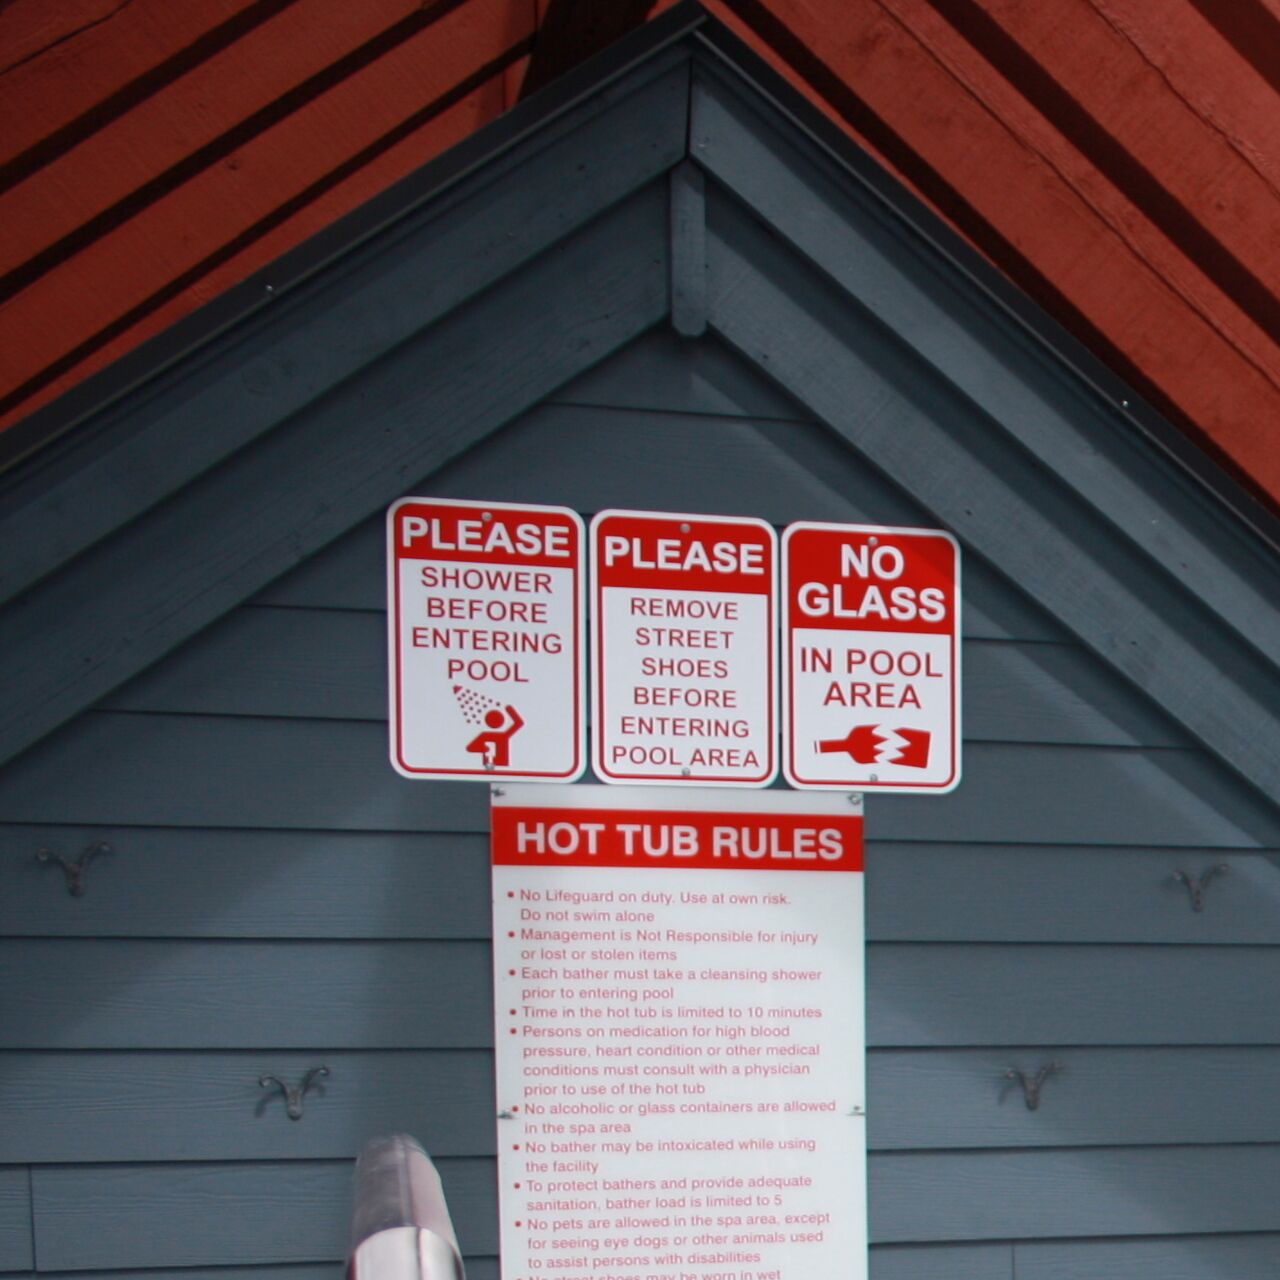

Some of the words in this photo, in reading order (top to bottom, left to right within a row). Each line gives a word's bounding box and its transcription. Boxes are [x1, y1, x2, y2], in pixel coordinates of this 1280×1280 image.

[402, 517, 570, 557] PLEASE
[604, 535, 764, 575] PLEASE
[841, 544, 904, 580] NO
[421, 566, 552, 595] SHOWER
[426, 597, 548, 624] BEFORE
[631, 597, 738, 621] REMOVE
[798, 582, 945, 622] GLASS
[412, 627, 563, 655] ENTERING
[635, 627, 734, 649] STREET
[447, 659, 529, 683] POOL
[641, 657, 728, 679] SHOES
[801, 647, 832, 674] IN
[846, 648, 943, 678] POOL
[633, 687, 737, 709] BEFORE
[823, 681, 921, 710] AREA
[620, 716, 749, 738] ENTERING
[612, 746, 682, 766] POOL
[690, 747, 759, 768] AREA
[517, 822, 605, 854] HOT
[617, 825, 698, 856] TUB
[713, 827, 843, 860] RULES
[520, 888, 541, 901] No
[546, 888, 613, 905] Lifeguard
[619, 892, 636, 902] on
[641, 890, 675, 906] duty.
[680, 890, 707, 903] Use
[712, 891, 724, 903] at
[729, 894, 757, 904] own
[763, 891, 790, 904] risk.
[521, 908, 541, 920] Do
[546, 908, 568, 921] not
[574, 908, 610, 921] swim
[615, 909, 654, 921] alone
[520, 928, 615, 944] Management
[620, 928, 632, 941] is
[636, 928, 661, 941] Not
[666, 928, 753, 945] Responsible
[757, 929, 776, 941] for
[780, 929, 817, 945] injury
[521, 950, 536, 960] or
[540, 947, 566, 960] lost
[571, 950, 586, 960] or
[591, 947, 634, 960] stolen
[639, 947, 677, 960] items
[521, 966, 557, 979] Each
[563, 967, 609, 979] bather
[614, 967, 648, 979] must
[653, 967, 683, 979] take
[688, 970, 696, 979] a
[700, 967, 767, 983] cleansing
[772, 967, 821, 980] shower
[522, 986, 555, 1002] prior
[560, 986, 574, 998] to
[579, 986, 638, 1002] entering
[641, 986, 673, 1002] pool
[522, 1024, 582, 1037] Persons
[586, 1027, 604, 1037] on
[609, 1024, 688, 1036] medication
[692, 1024, 711, 1036] for
[715, 1024, 746, 1040] high
[750, 1024, 789, 1036] blood
[523, 1046, 590, 1059] pressure,
[596, 1043, 632, 1056] heart
[637, 1043, 702, 1056] condition
[707, 1046, 721, 1056] or
[725, 1043, 762, 1055] other
[766, 1043, 819, 1055] medical
[525, 1101, 545, 1114] No
[550, 1101, 614, 1114] alcoholic
[619, 1104, 635, 1113] or
[638, 1100, 675, 1116] glass
[680, 1099, 753, 1113] containers
[757, 1102, 779, 1112] are
[784, 1099, 836, 1112] allowed
[525, 1121, 537, 1133] in
[542, 1121, 565, 1133] the
[570, 1123, 595, 1136] spa
[600, 1123, 631, 1133] area
[525, 1140, 546, 1153] No
[551, 1139, 596, 1152] bather
[602, 1142, 631, 1155] may
[636, 1139, 653, 1151] be
[658, 1138, 734, 1151] intoxicated
[738, 1137, 774, 1150] while
[779, 1137, 815, 1153] using
[526, 1159, 548, 1172] the
[553, 1159, 598, 1175] facility
[527, 1178, 542, 1192] To
[548, 1177, 598, 1194] protect
[602, 1176, 656, 1190] bathers
[660, 1176, 687, 1189] and
[691, 1175, 743, 1192] provide
[748, 1174, 812, 1191] adequate
[527, 1217, 548, 1230] No
[552, 1216, 583, 1232] pets
[587, 1218, 610, 1228] are
[615, 1214, 671, 1228] allowed
[674, 1214, 686, 1227] in
[691, 1213, 712, 1226] the
[717, 1216, 742, 1229] spa
[746, 1215, 780, 1227] area,
[784, 1211, 830, 1227] except
[528, 1255, 542, 1268] to
[546, 1254, 588, 1268] assist
[593, 1256, 650, 1270] persons
[654, 1252, 683, 1265] with
[687, 1250, 761, 1264] disabilities
[740, 1269, 752, 1280] in
[757, 1268, 780, 1280] wet
